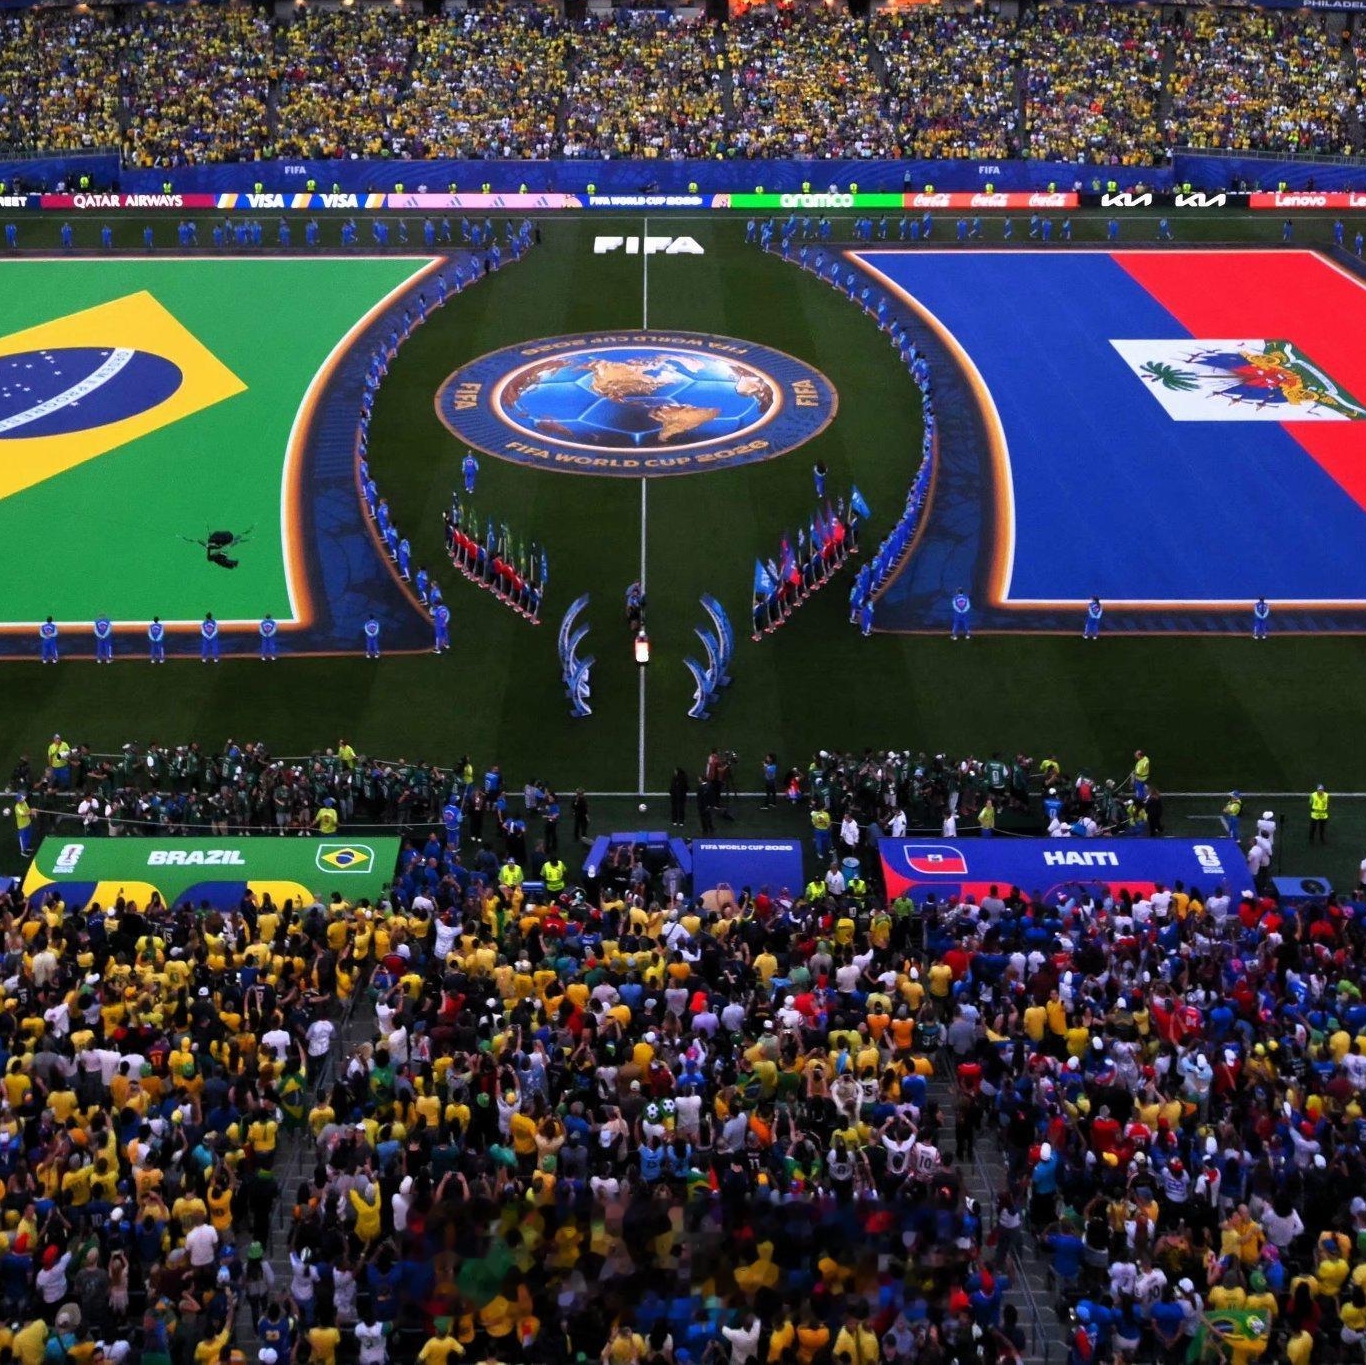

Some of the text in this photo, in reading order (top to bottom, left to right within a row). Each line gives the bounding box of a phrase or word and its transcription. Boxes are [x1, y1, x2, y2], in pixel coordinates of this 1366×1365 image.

[284, 165, 306, 175] FIFA
[978, 165, 1000, 175] FIFA
[73, 195, 183, 209] QATAR AIRWAYS
[246, 194, 285, 208] VISA
[320, 193, 359, 208] VISA
[589, 196, 610, 206] FIFA
[610, 196, 646, 206] WORLD
[645, 196, 666, 206] CUP
[780, 192, 855, 208] aramco
[1275, 194, 1327, 207] Lenovo
[593, 235, 705, 254] FIFA
[453, 382, 483, 411] FIFA
[791, 378, 820, 408] FIFA
[505, 439, 770, 468] FIFA WORLD CUP 2026
[764, 844, 794, 852] 2026
[146, 849, 246, 866] BRAZIL
[1043, 850, 1120, 866] HAITI
[918, 1154, 933, 1170] 10
